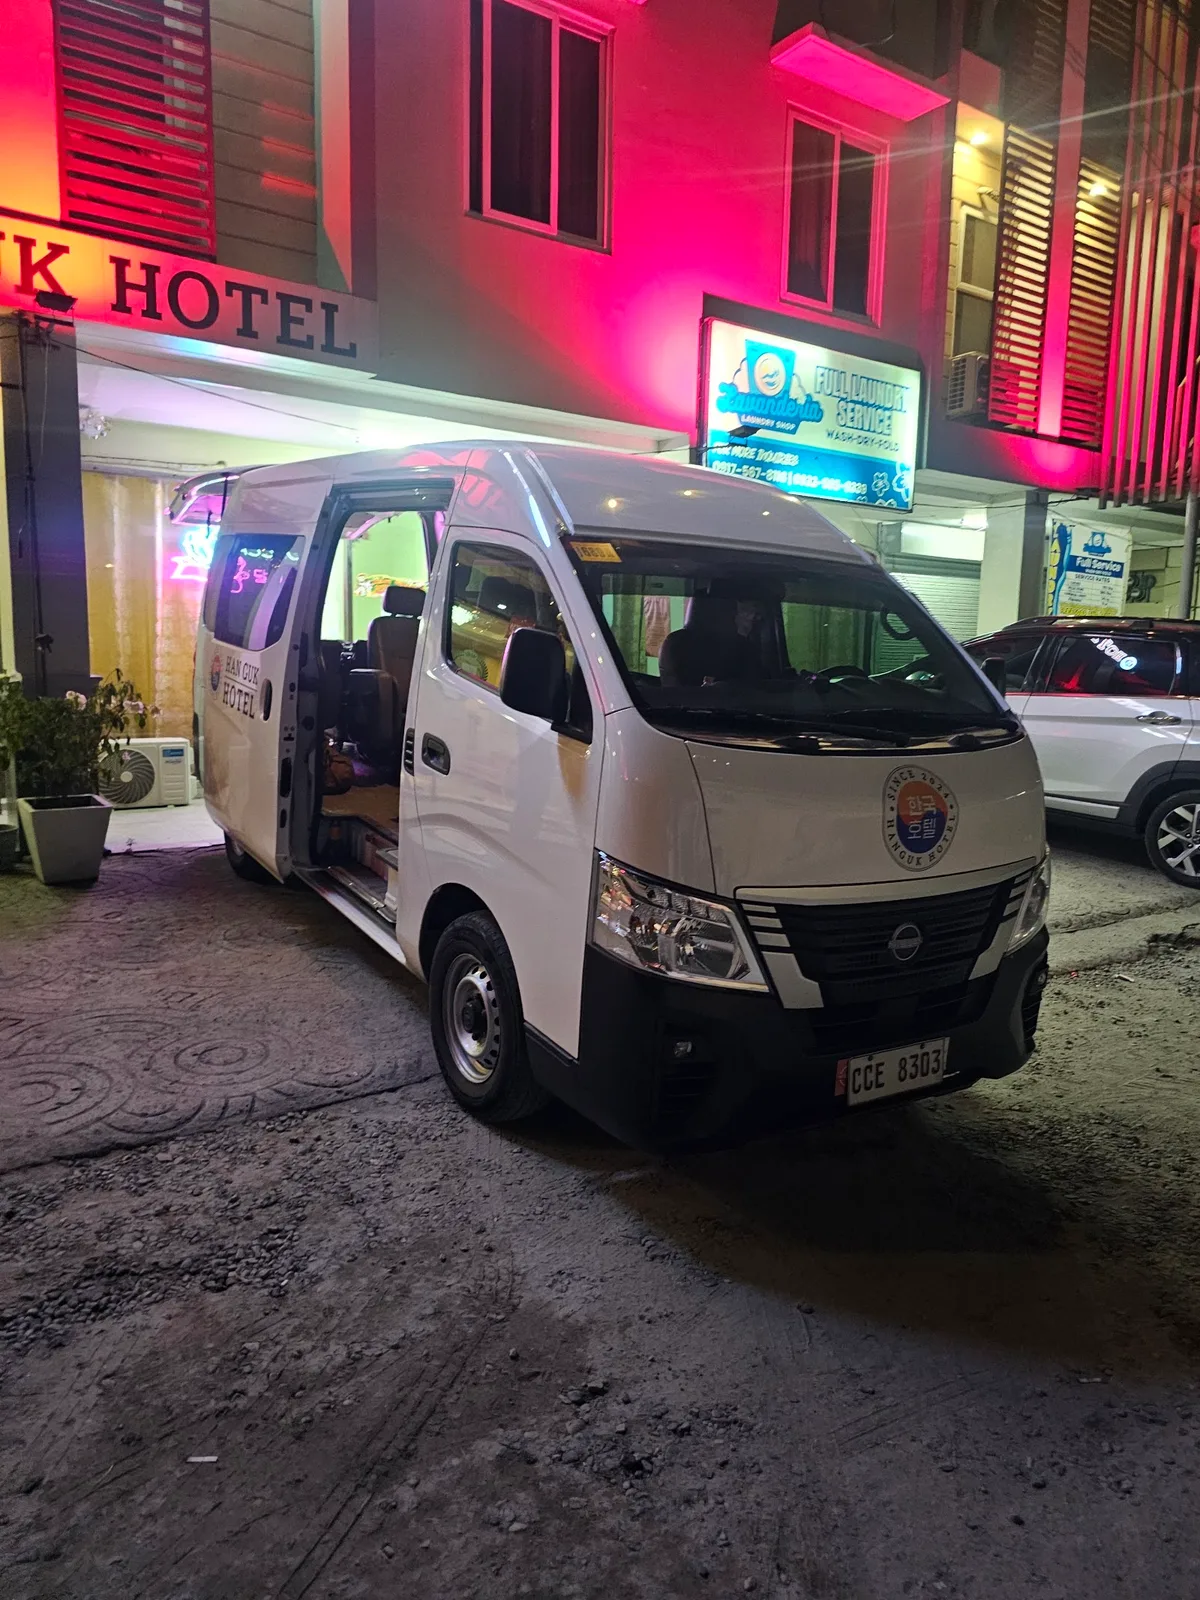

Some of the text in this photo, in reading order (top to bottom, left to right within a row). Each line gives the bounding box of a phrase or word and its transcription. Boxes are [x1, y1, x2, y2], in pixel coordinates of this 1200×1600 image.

[109, 255, 357, 358] HOTEL
[814, 365, 848, 399] FULL
[741, 414, 796, 431] LAUNDRY SHOP
[837, 400, 892, 436] SERVICE
[731, 446, 757, 461] MORE
[1076, 557, 1121, 572] Full Service
[225, 656, 259, 686] HAN GUK
[223, 681, 255, 719] HOTEL
[887, 769, 949, 801] SINCE 2024
[887, 815, 956, 866] HANGUK HOTEL
[907, 818, 937, 840] 호텔
[852, 1049, 941, 1095] CCE 8303
